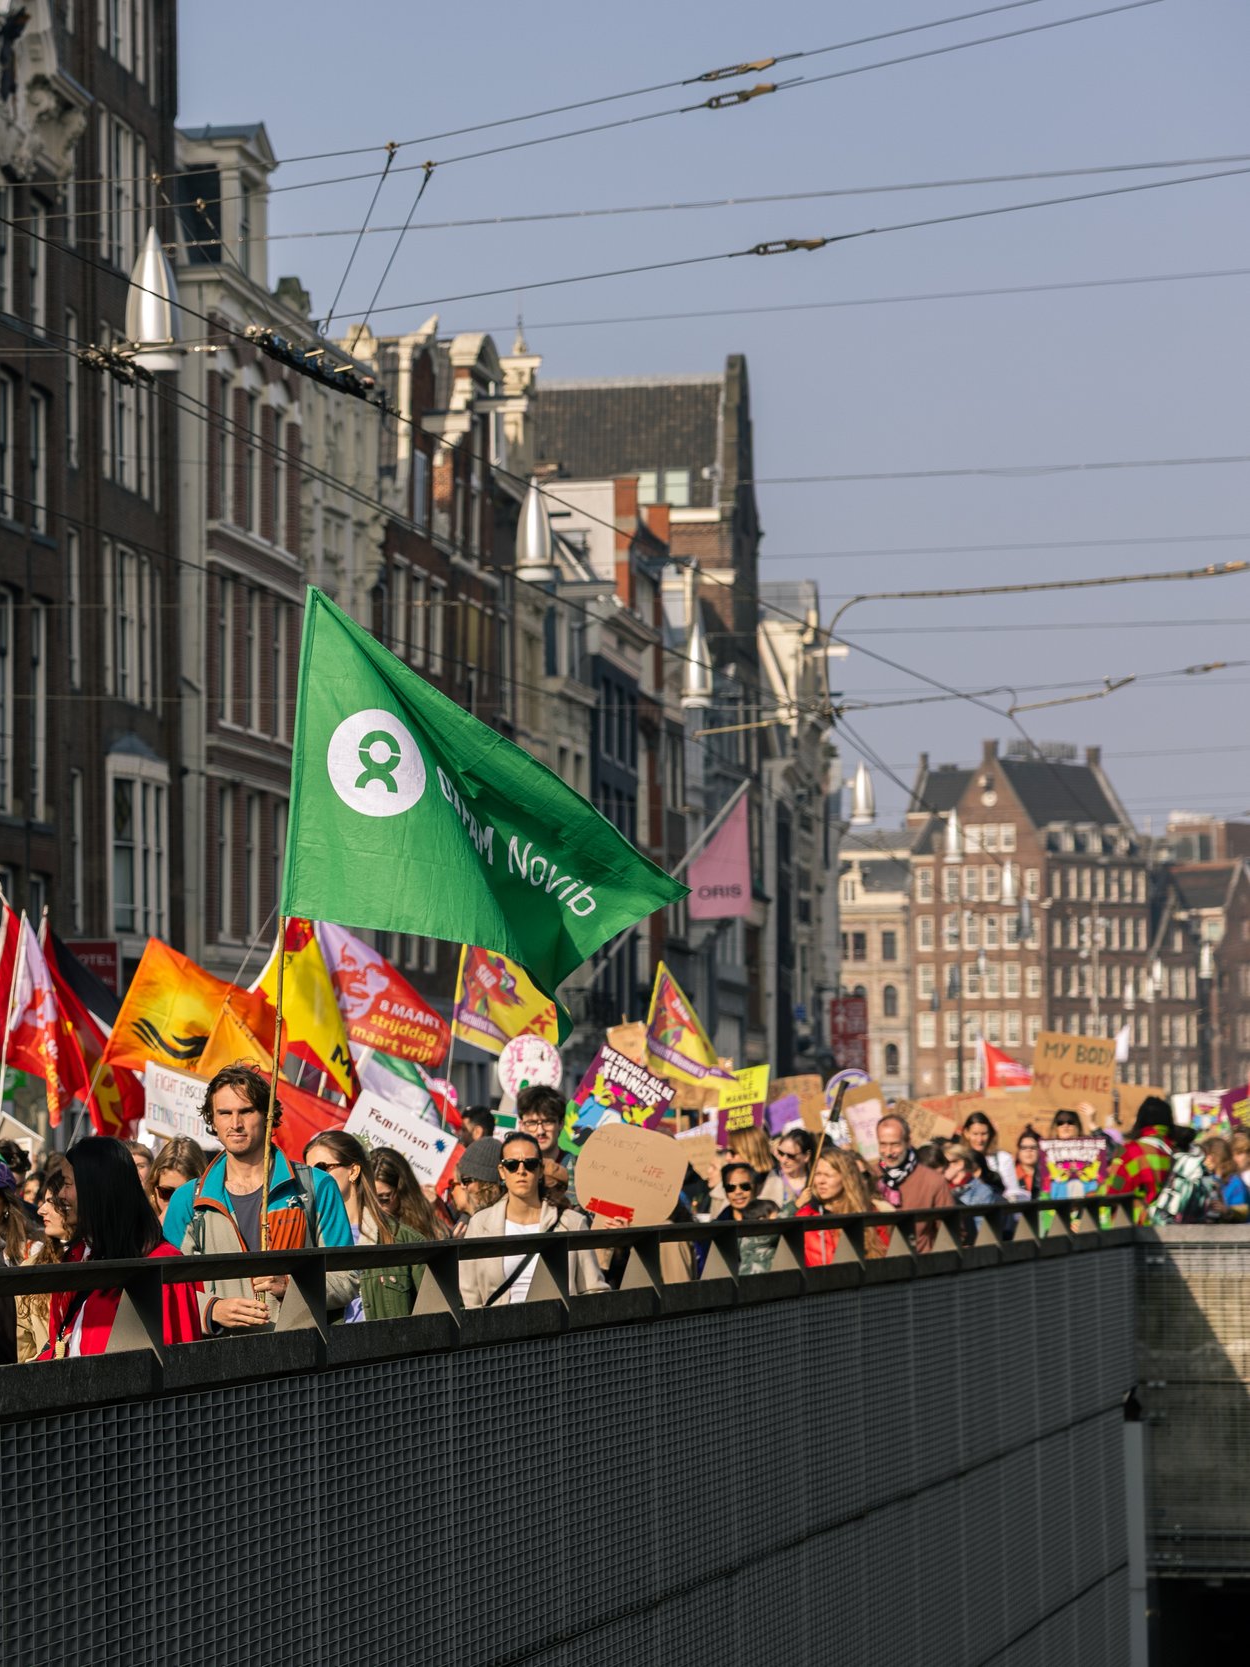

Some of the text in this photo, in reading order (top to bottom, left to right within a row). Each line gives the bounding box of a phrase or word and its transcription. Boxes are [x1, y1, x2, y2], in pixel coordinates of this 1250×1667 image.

[698, 884, 742, 900] ORIS
[77, 953, 116, 966] OTEL
[379, 1000, 440, 1029] 8 MAART
[351, 1025, 398, 1050] maart
[370, 1013, 438, 1047] strijddag
[1043, 1042, 1115, 1068] MY BODY
[601, 1046, 617, 1062] WE
[615, 1056, 649, 1082] SHOULD
[647, 1077, 664, 1095] ALL
[603, 1061, 662, 1106] FEMINISTS
[1060, 1071, 1111, 1094] CHOICE
[155, 1072, 208, 1100] FIGHT FASCIS
[368, 1107, 429, 1150] Feminism
